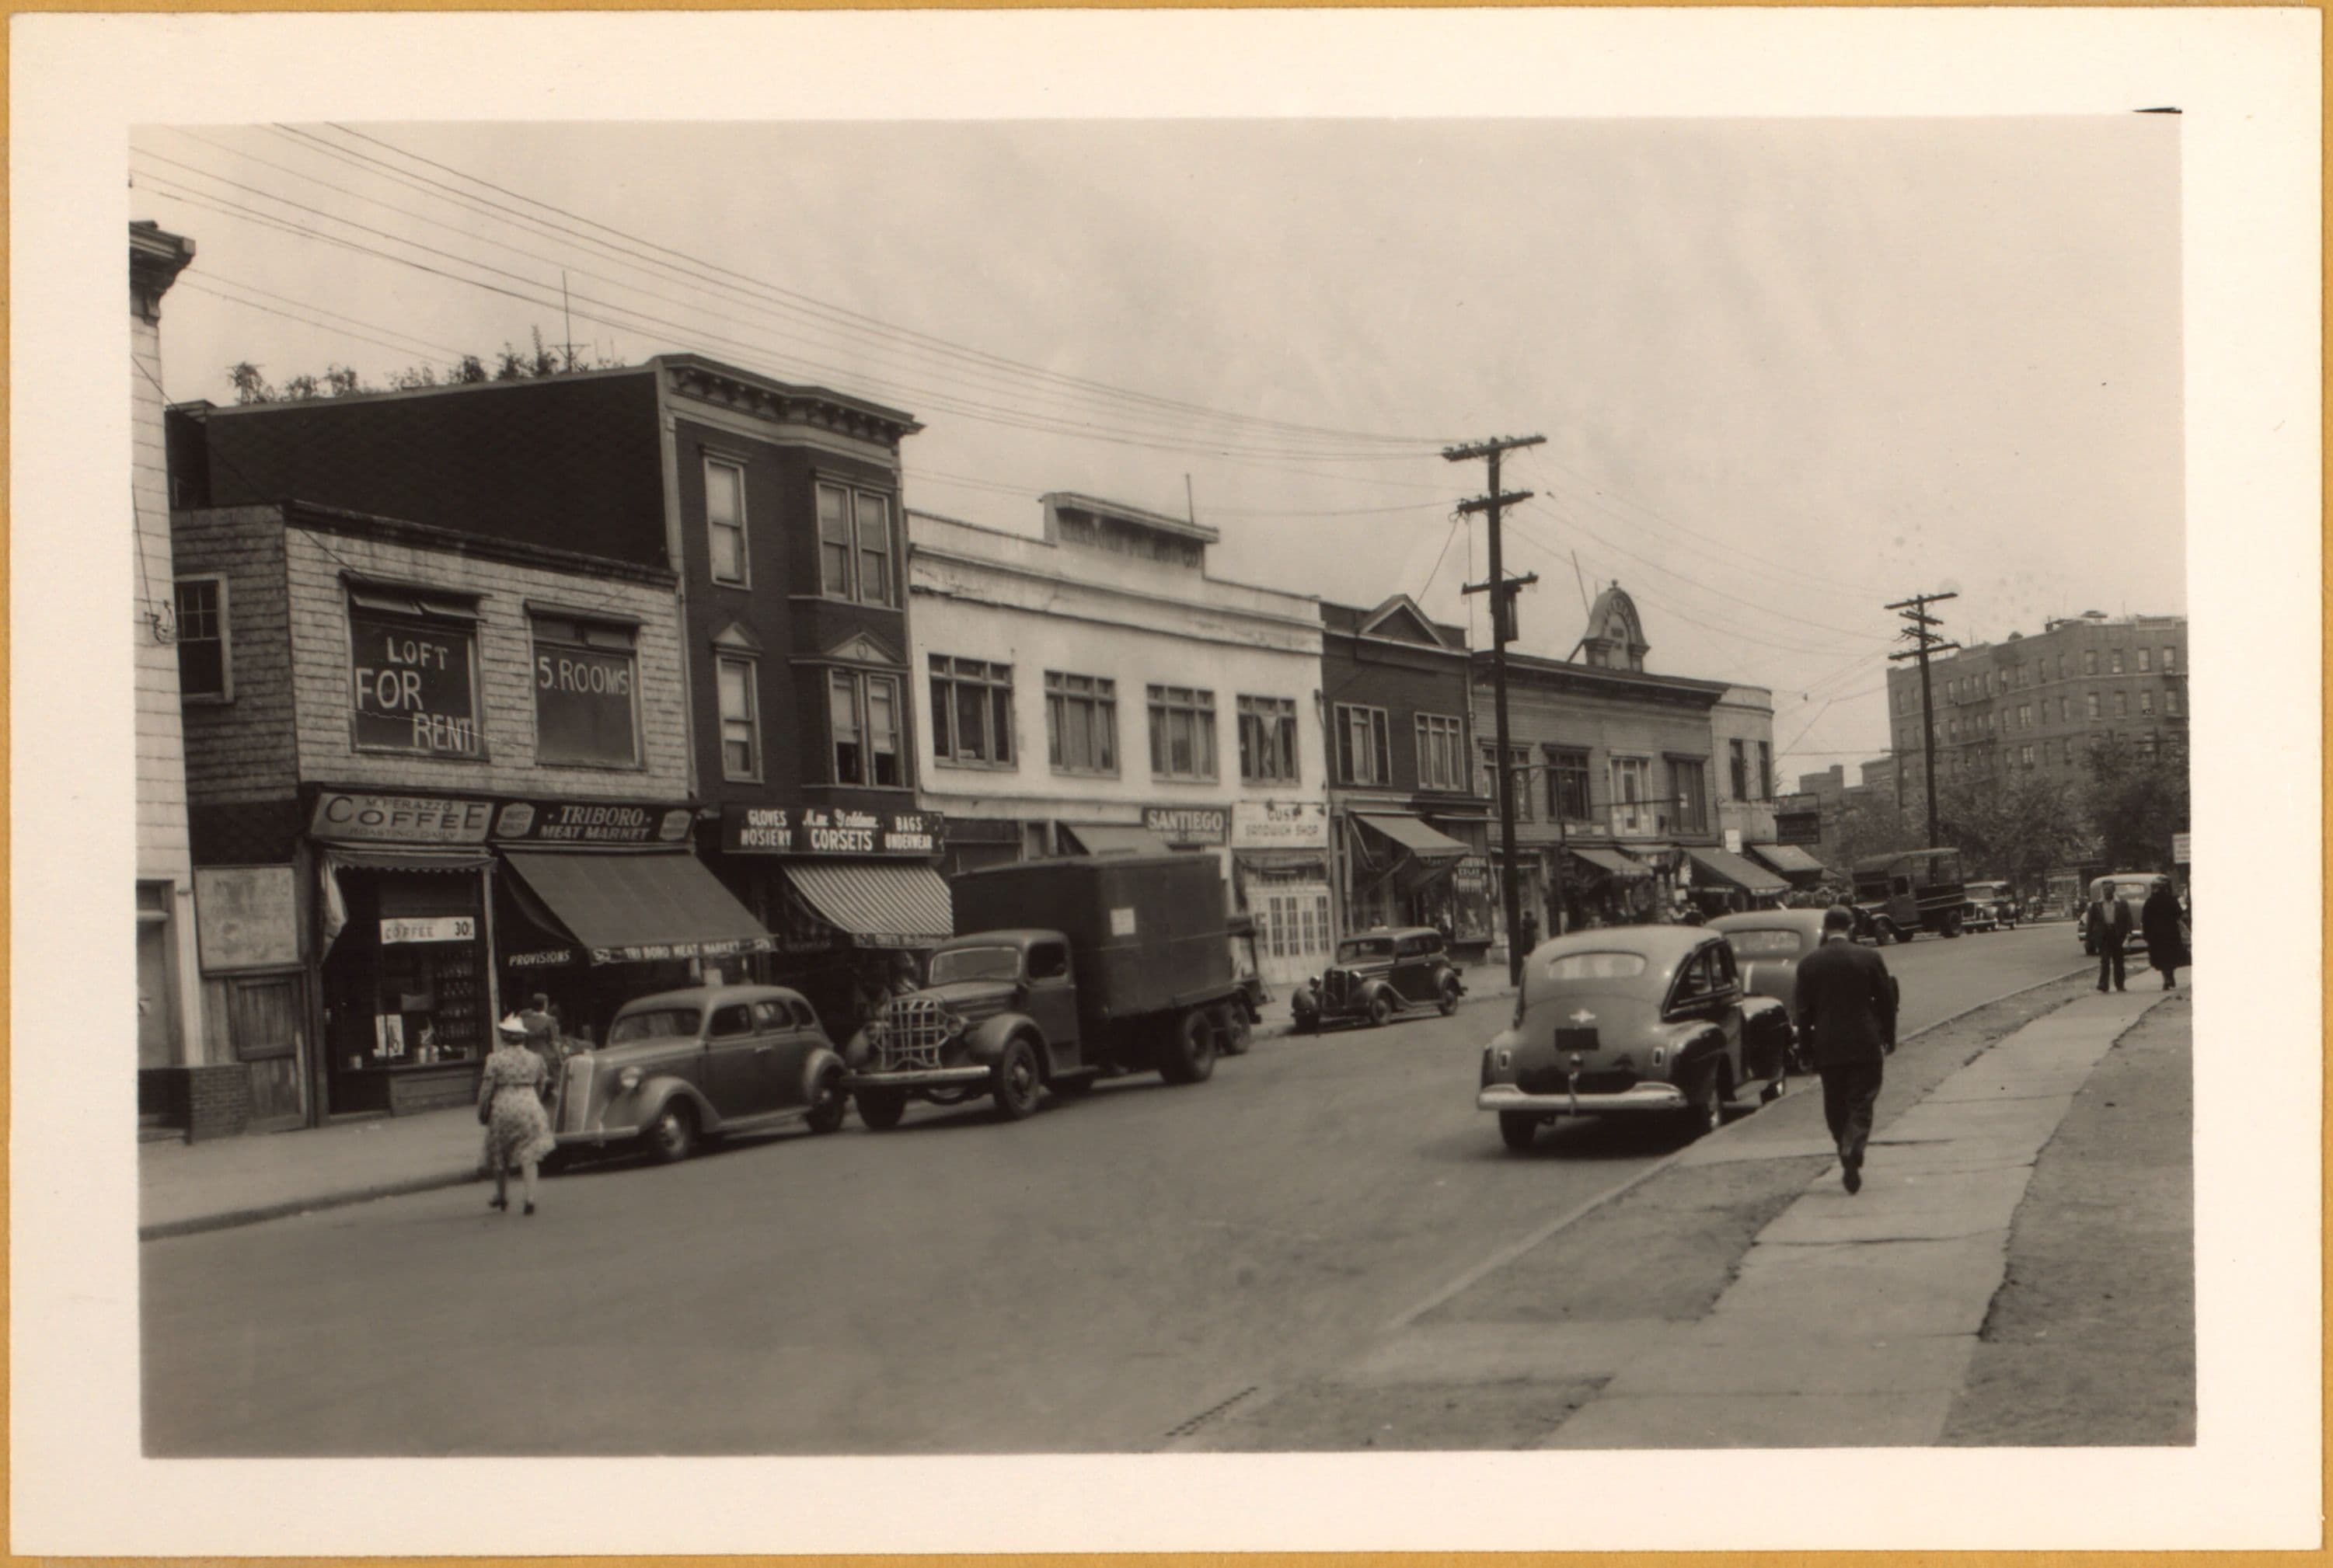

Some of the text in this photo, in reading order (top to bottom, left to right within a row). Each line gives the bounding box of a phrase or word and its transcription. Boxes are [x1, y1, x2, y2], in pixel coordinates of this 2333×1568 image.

[387, 636, 449, 671] LOFT
[354, 667, 424, 711] FOR
[413, 713, 475, 753] RENT
[325, 795, 487, 830] COFFEE
[560, 805, 644, 828] TRIBORO
[748, 809, 787, 828] GLOVES
[1148, 810, 1224, 831] SANTIEGO
[539, 824, 584, 839] MEAT
[584, 826, 650, 840] MARKET
[895, 816, 922, 832] BAGS
[741, 829, 791, 846] HOSIERY
[811, 828, 874, 852] CORSETS
[884, 833, 933, 850] UNDERWEAR
[385, 925, 434, 939] COFFEE
[508, 950, 570, 967] PROVISIONS
